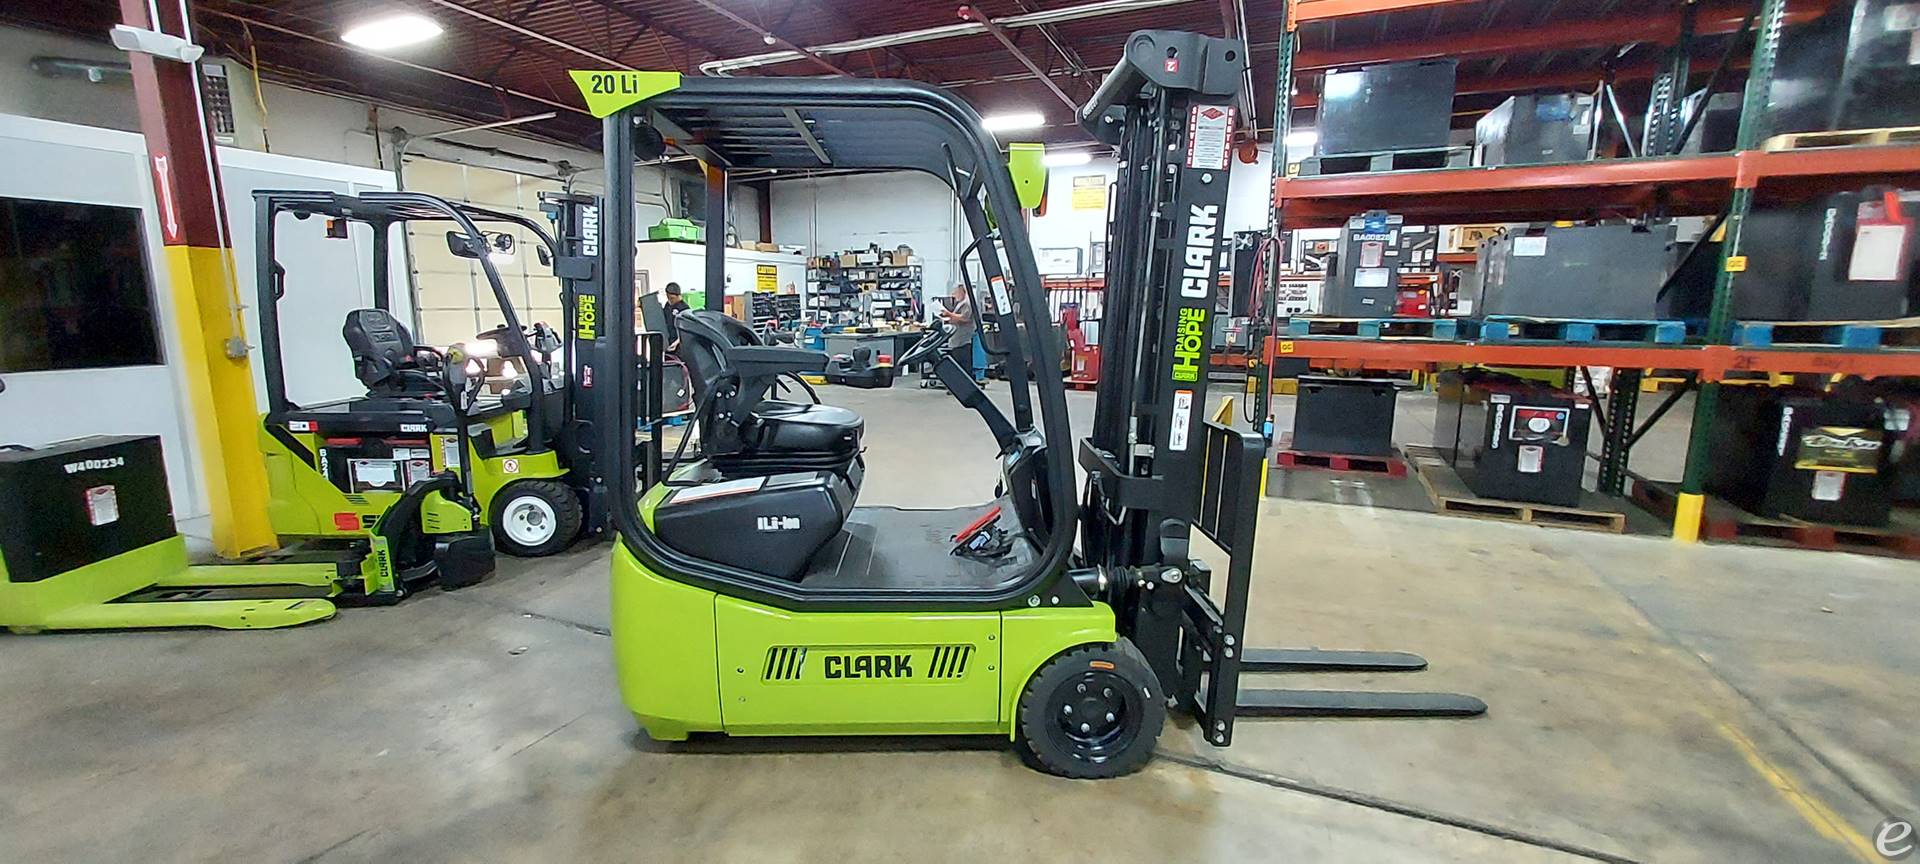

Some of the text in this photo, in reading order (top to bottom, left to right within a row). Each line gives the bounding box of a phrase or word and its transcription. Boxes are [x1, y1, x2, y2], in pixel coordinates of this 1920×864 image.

[591, 75, 638, 94] 20 Li
[1186, 106, 1198, 165] SERVICE
[1223, 108, 1234, 167] RENTALS
[582, 205, 599, 256] CLARK
[1180, 204, 1219, 299] CLARK
[579, 295, 596, 335] HOPE
[1175, 307, 1189, 351] RAISING
[1173, 308, 1206, 372] HOPE
[400, 424, 428, 433] CLARK
[63, 456, 125, 474] W400234
[376, 549, 389, 577] CLARK
[824, 655, 913, 679] CLARK
